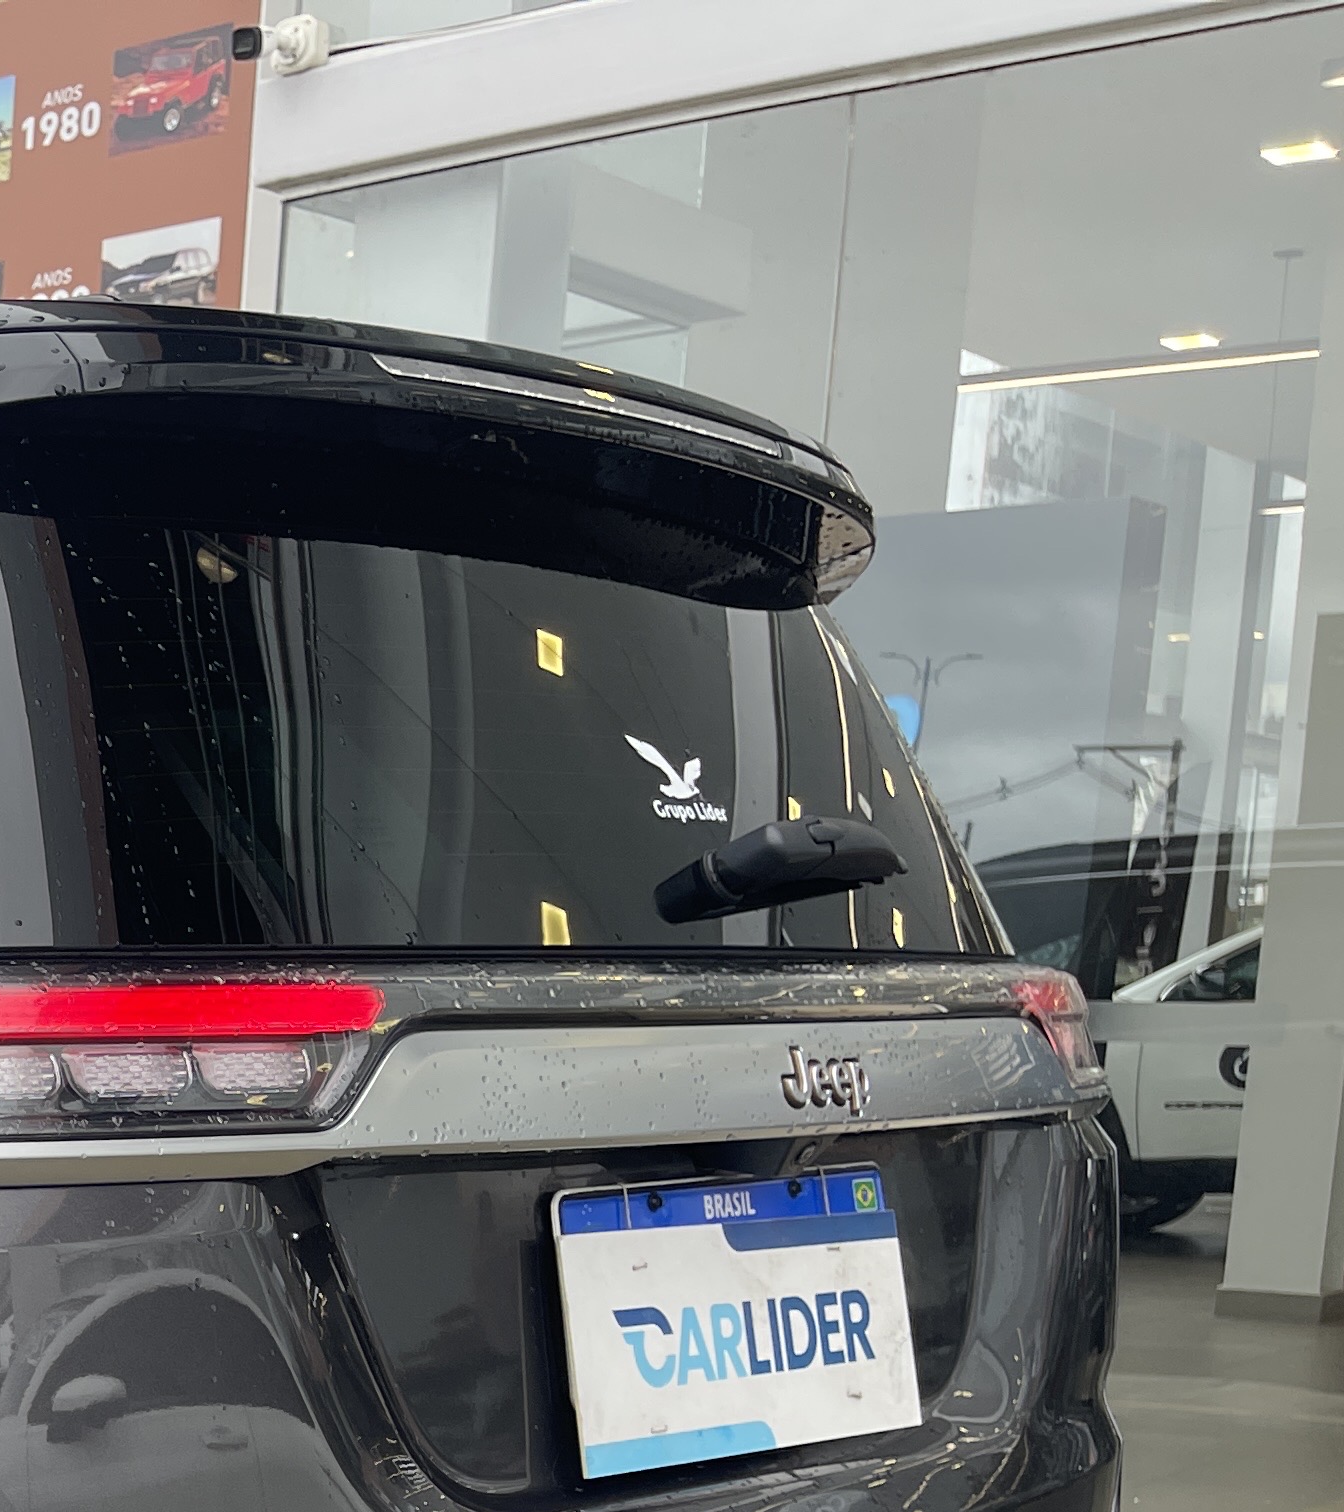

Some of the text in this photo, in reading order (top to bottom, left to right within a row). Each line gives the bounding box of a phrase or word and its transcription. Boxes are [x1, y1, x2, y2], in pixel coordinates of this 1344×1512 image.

[42, 84, 83, 107] ANOS
[21, 102, 101, 150] 1980
[31, 267, 72, 290] ANOS
[652, 799, 696, 824] Grupo
[780, 1045, 871, 1118] Jeep
[703, 1191, 756, 1219] BRASIL
[612, 1289, 876, 1388] CARLIDER
